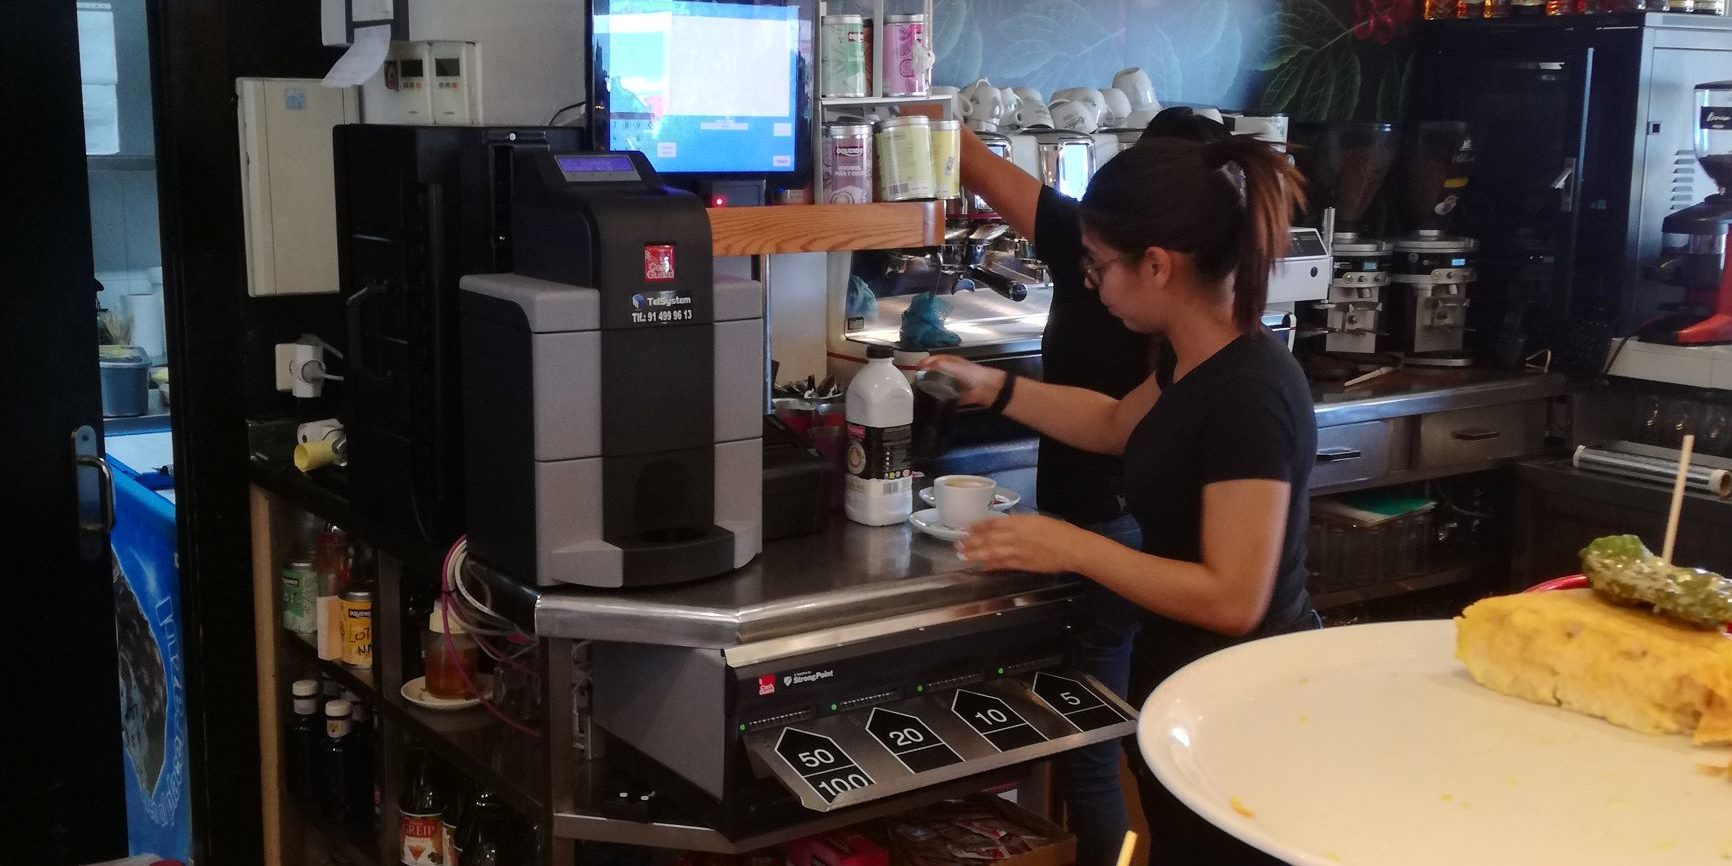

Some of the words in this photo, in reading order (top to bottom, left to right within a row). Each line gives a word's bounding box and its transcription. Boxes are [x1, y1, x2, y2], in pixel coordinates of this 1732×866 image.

[646, 296, 691, 306] TelSystem
[647, 311, 657, 322] 91
[658, 310, 672, 321] 499
[673, 310, 682, 320] 96
[684, 309, 693, 320] 13
[793, 669, 834, 684] StrongPoint
[1058, 691, 1082, 706] 5
[974, 708, 1008, 725] 10
[888, 727, 924, 747] 20
[798, 748, 836, 768] 50
[817, 773, 869, 797] 100
